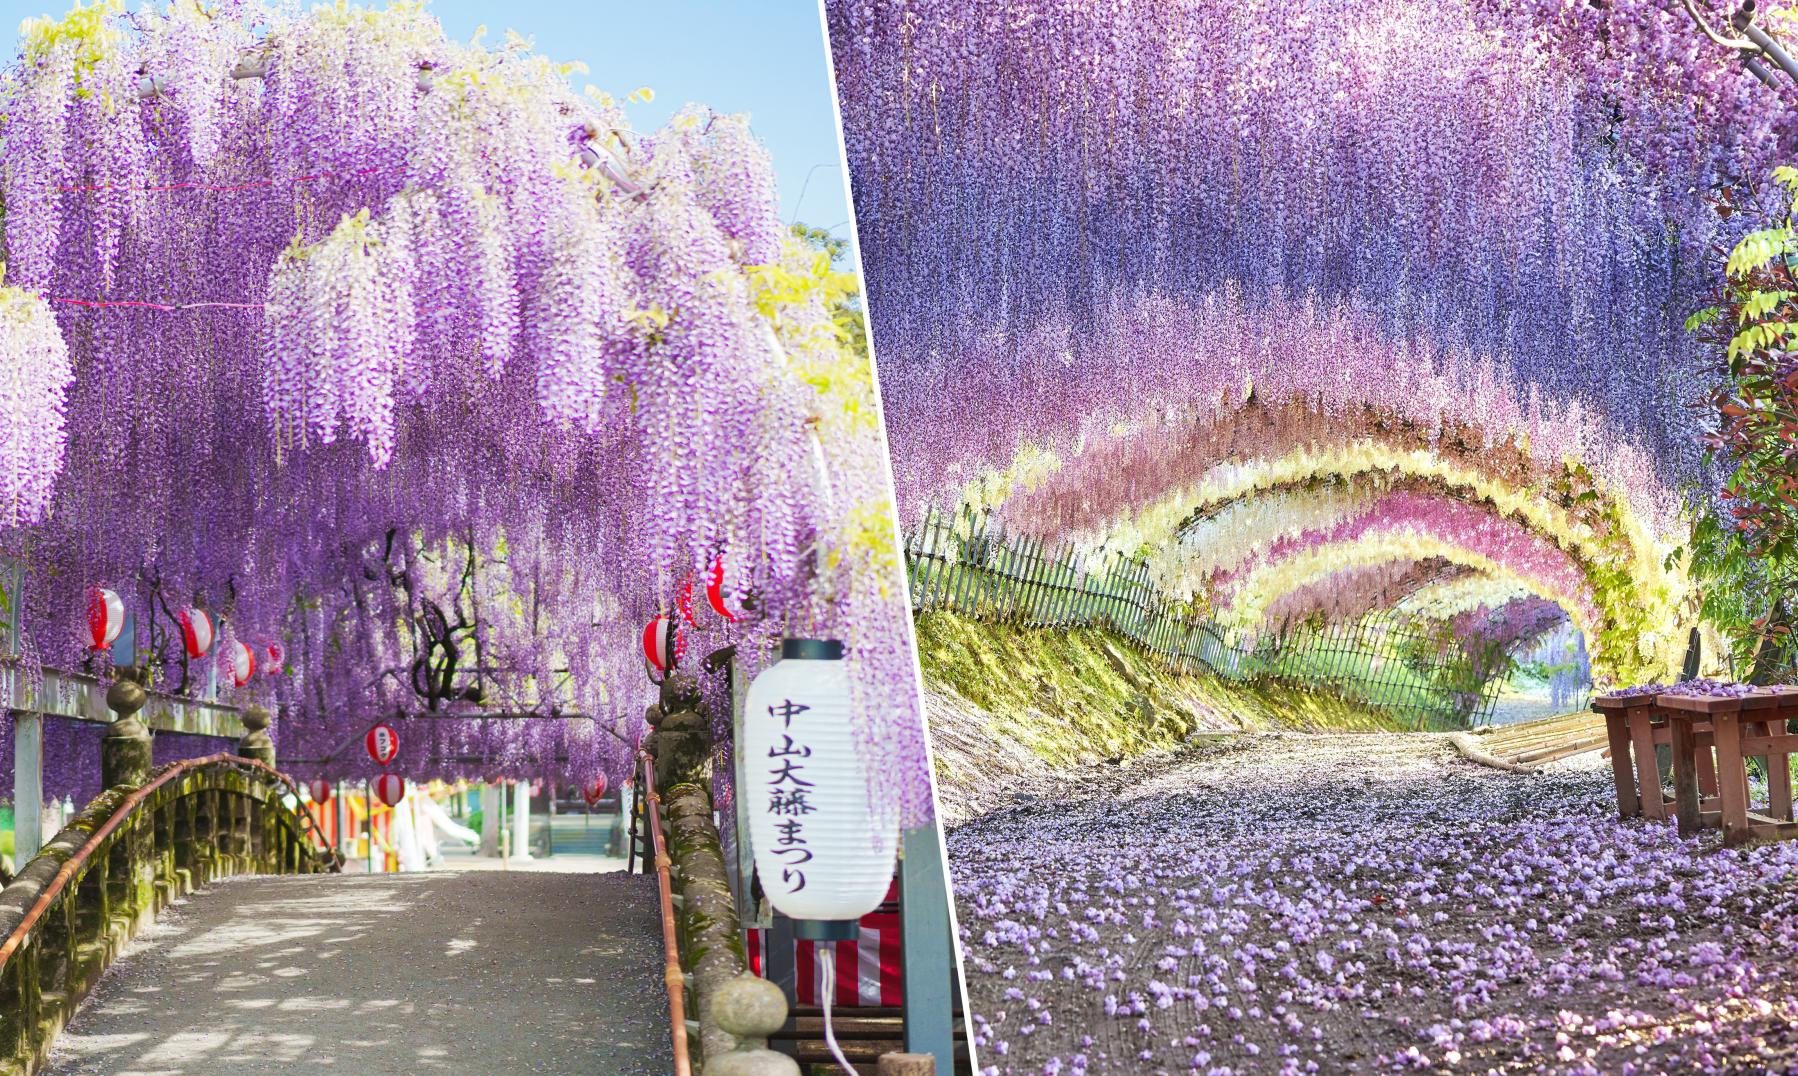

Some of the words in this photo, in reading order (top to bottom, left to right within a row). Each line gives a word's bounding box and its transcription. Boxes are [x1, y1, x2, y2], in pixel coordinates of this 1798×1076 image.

[767, 699, 817, 893] 中山大藤まつり
